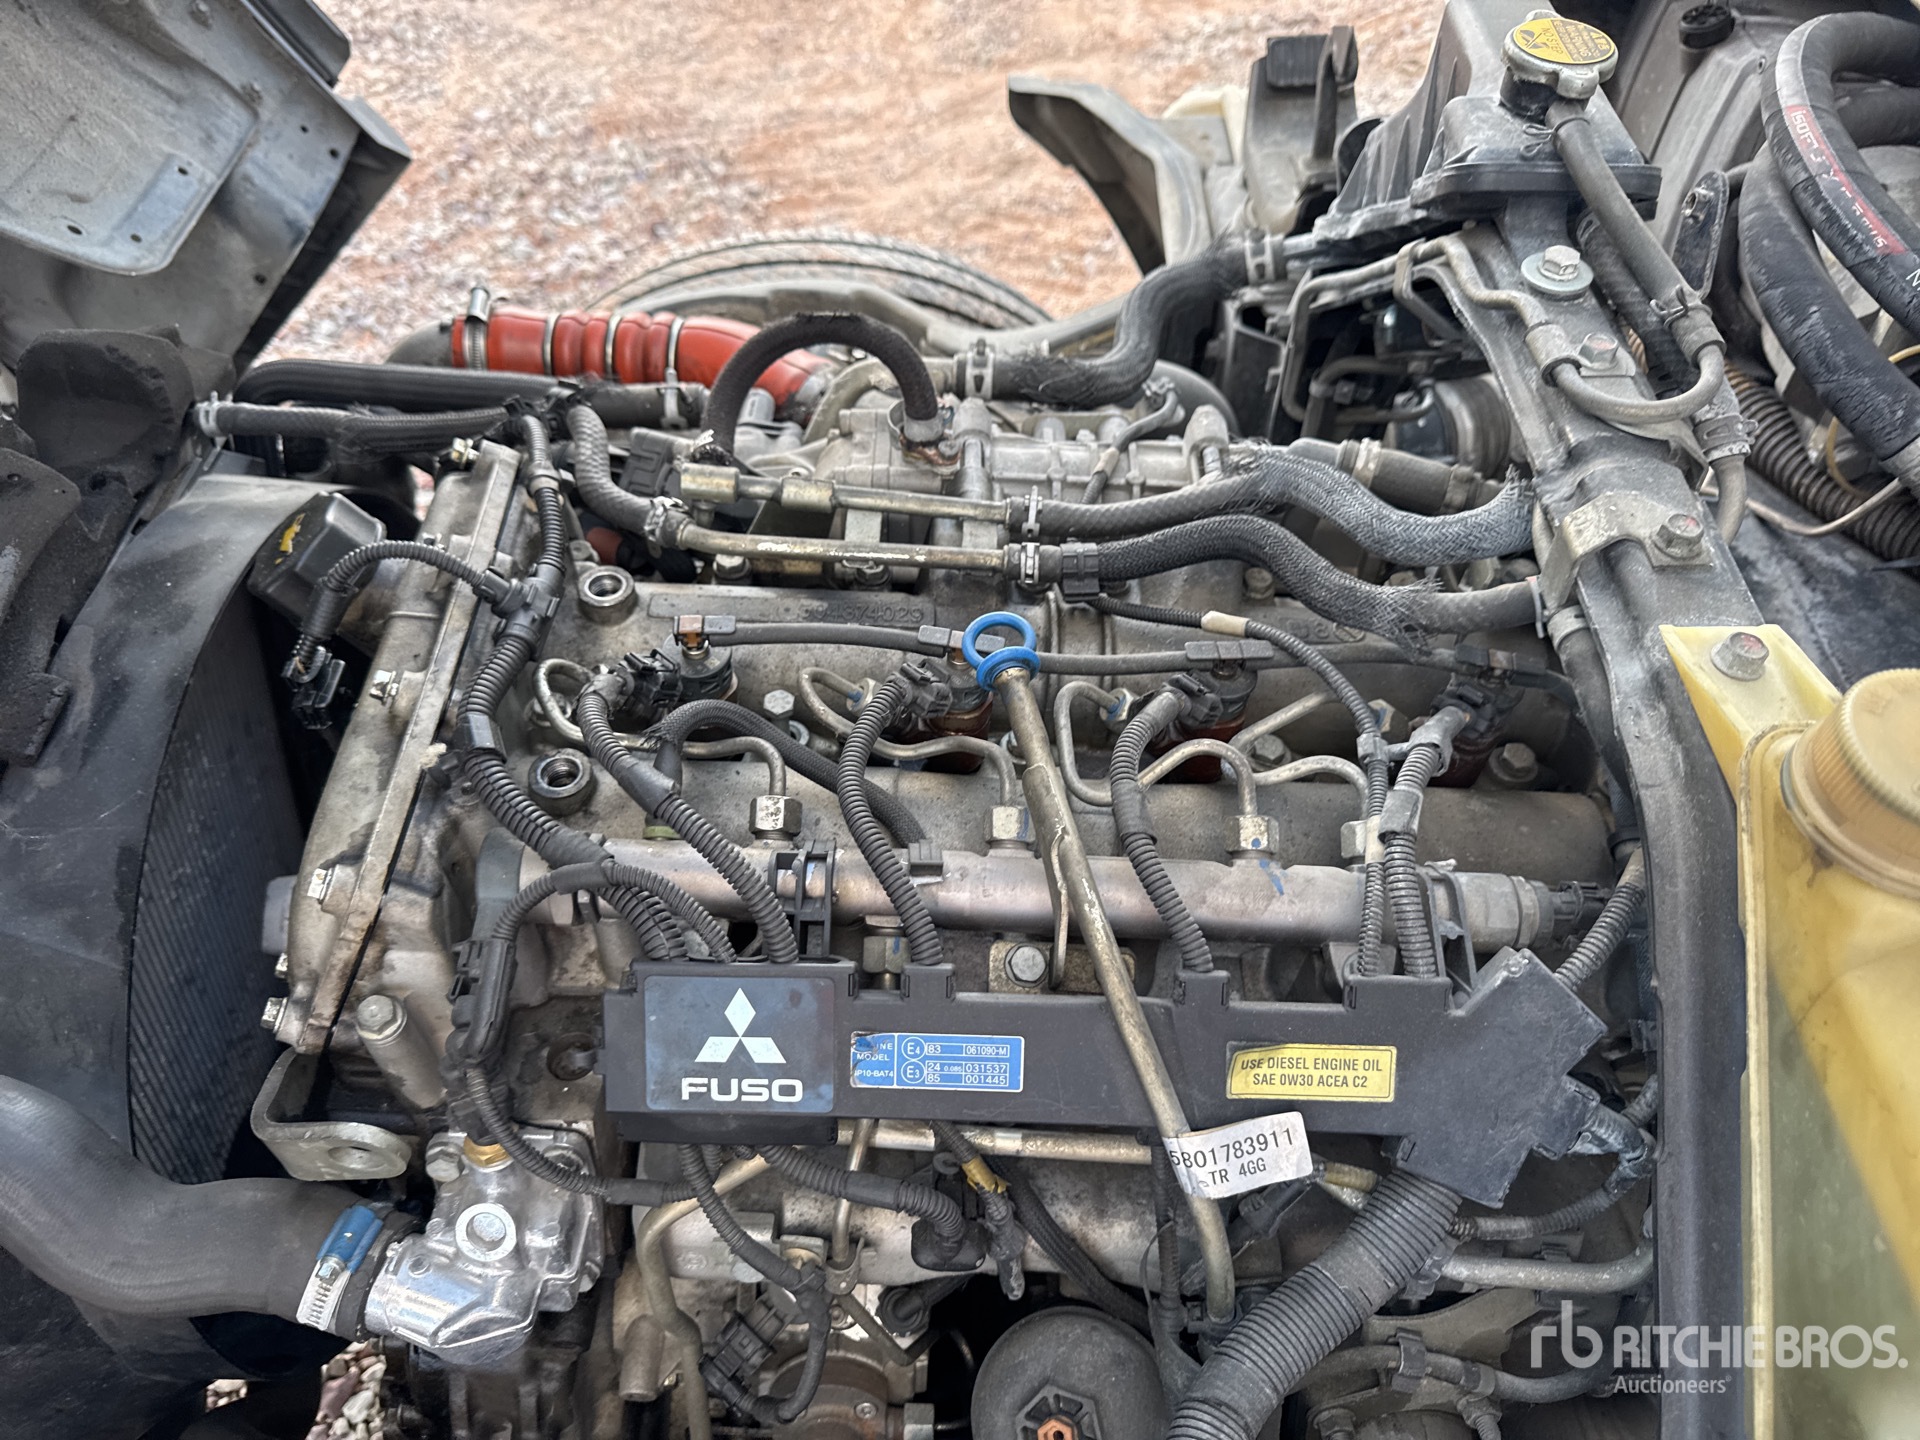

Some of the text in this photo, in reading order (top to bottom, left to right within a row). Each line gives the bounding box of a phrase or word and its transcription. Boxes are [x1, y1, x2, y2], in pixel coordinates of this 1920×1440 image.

[856, 1053, 890, 1061] MODEL
[928, 1044, 1007, 1056] 83 061090-M
[927, 1062, 940, 1072] 24
[965, 1063, 1006, 1074] 031537
[1241, 1057, 1383, 1072] USE DIESEL ENGINE OIL
[927, 1073, 1006, 1085] 85 001445
[1252, 1073, 1276, 1086] SAE
[1317, 1075, 1349, 1088] ACEA
[1352, 1076, 1368, 1088] C2
[681, 1077, 803, 1102] FUSO
[1170, 1127, 1294, 1169] 5801783911
[1238, 1157, 1267, 1177] 4GG
